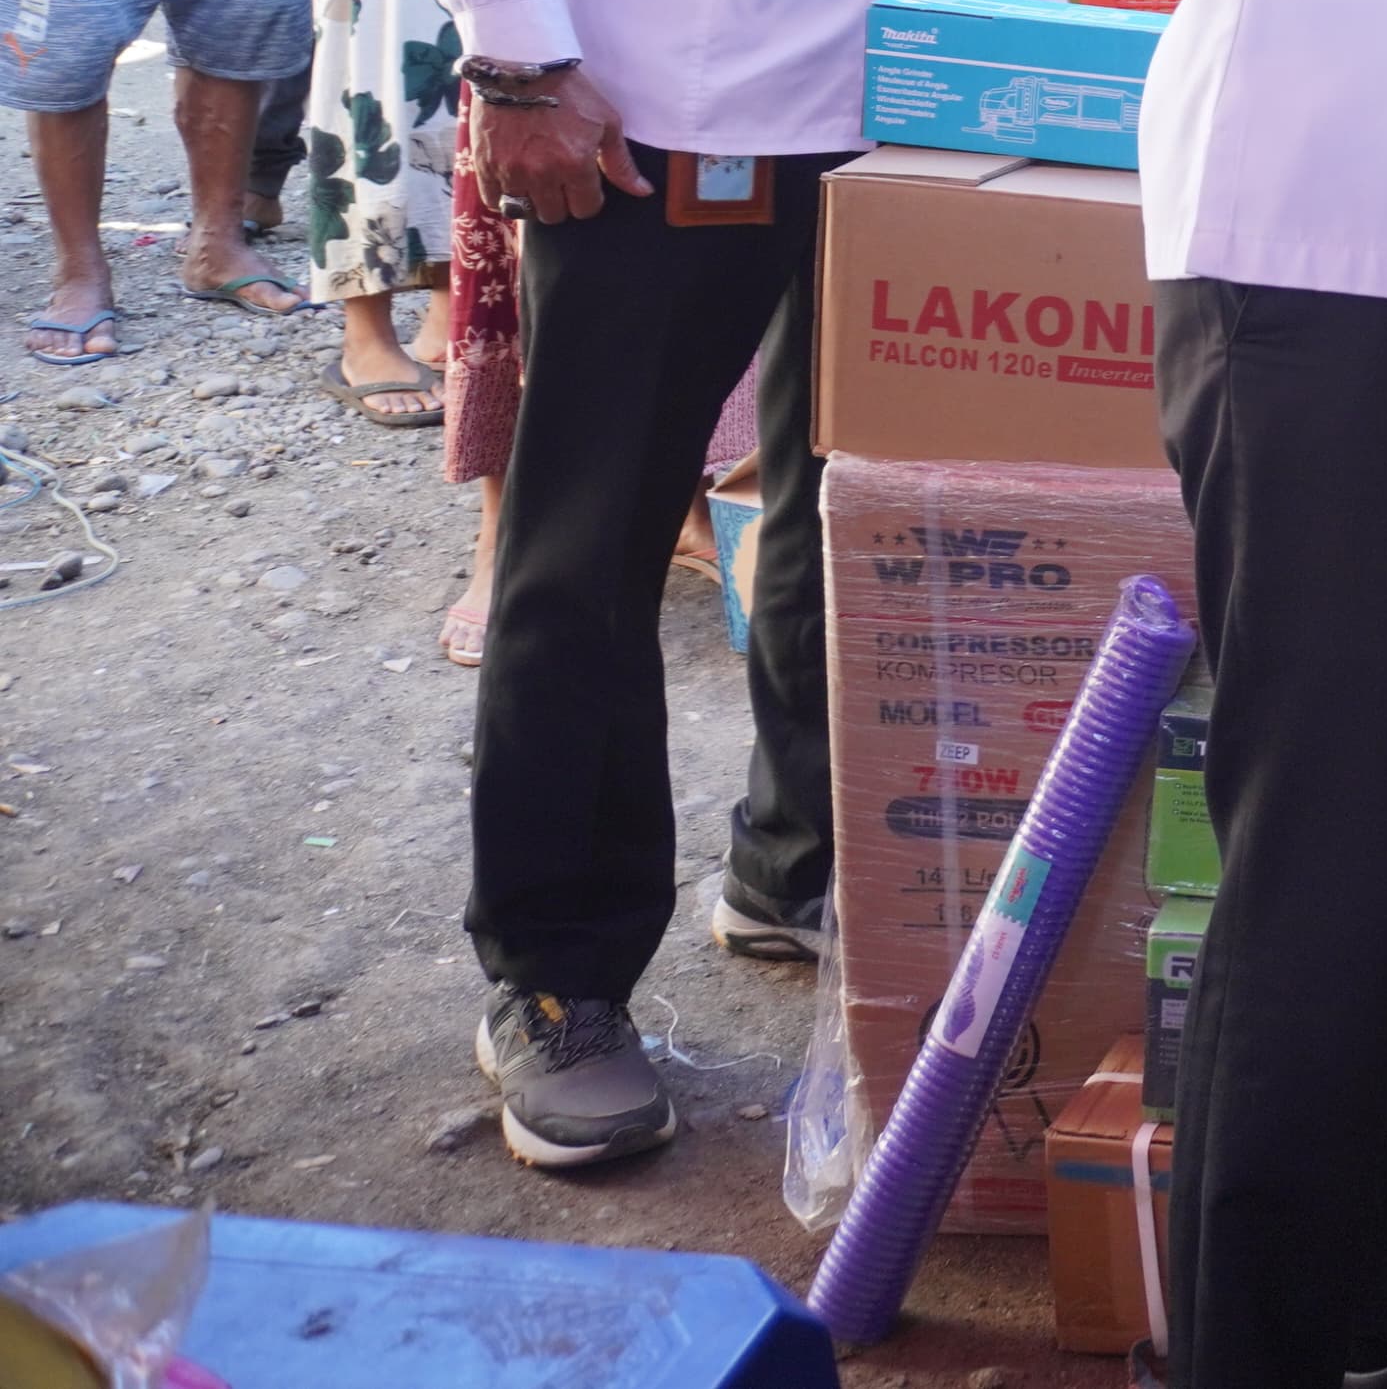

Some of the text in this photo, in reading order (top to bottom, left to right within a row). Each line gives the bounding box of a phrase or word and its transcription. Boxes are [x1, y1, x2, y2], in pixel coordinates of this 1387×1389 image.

[870, 279, 1155, 356] LAKONI
[868, 340, 1155, 384] FALCON 120e Inverter
[872, 559, 1072, 591] WPRO
[939, 744, 971, 760] ZEEP
